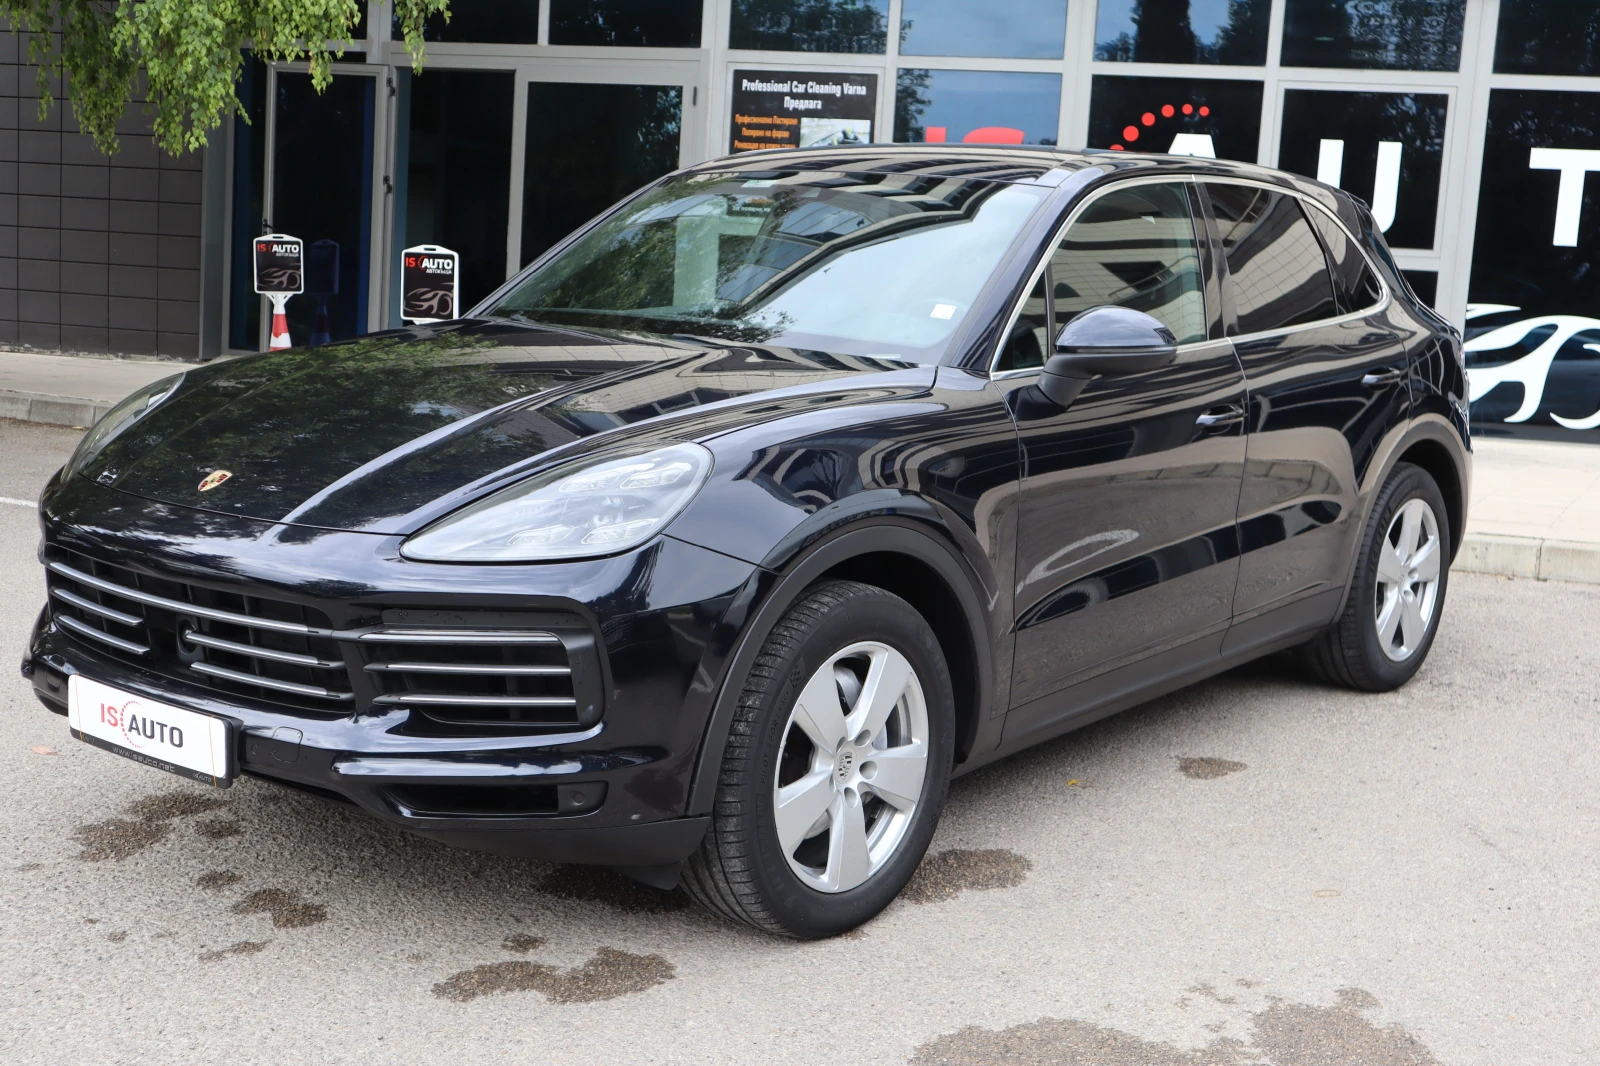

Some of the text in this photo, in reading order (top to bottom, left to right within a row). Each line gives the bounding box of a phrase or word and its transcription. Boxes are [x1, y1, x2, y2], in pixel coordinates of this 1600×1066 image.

[742, 79, 867, 97] Professional Car Cleaning Varna
[784, 96, 822, 111] Предлага
[257, 244, 299, 253] IS AUTO
[405, 257, 453, 270] IS AUTO
[101, 703, 184, 748] IS AUTO
[112, 746, 176, 773] www.isauto.net
